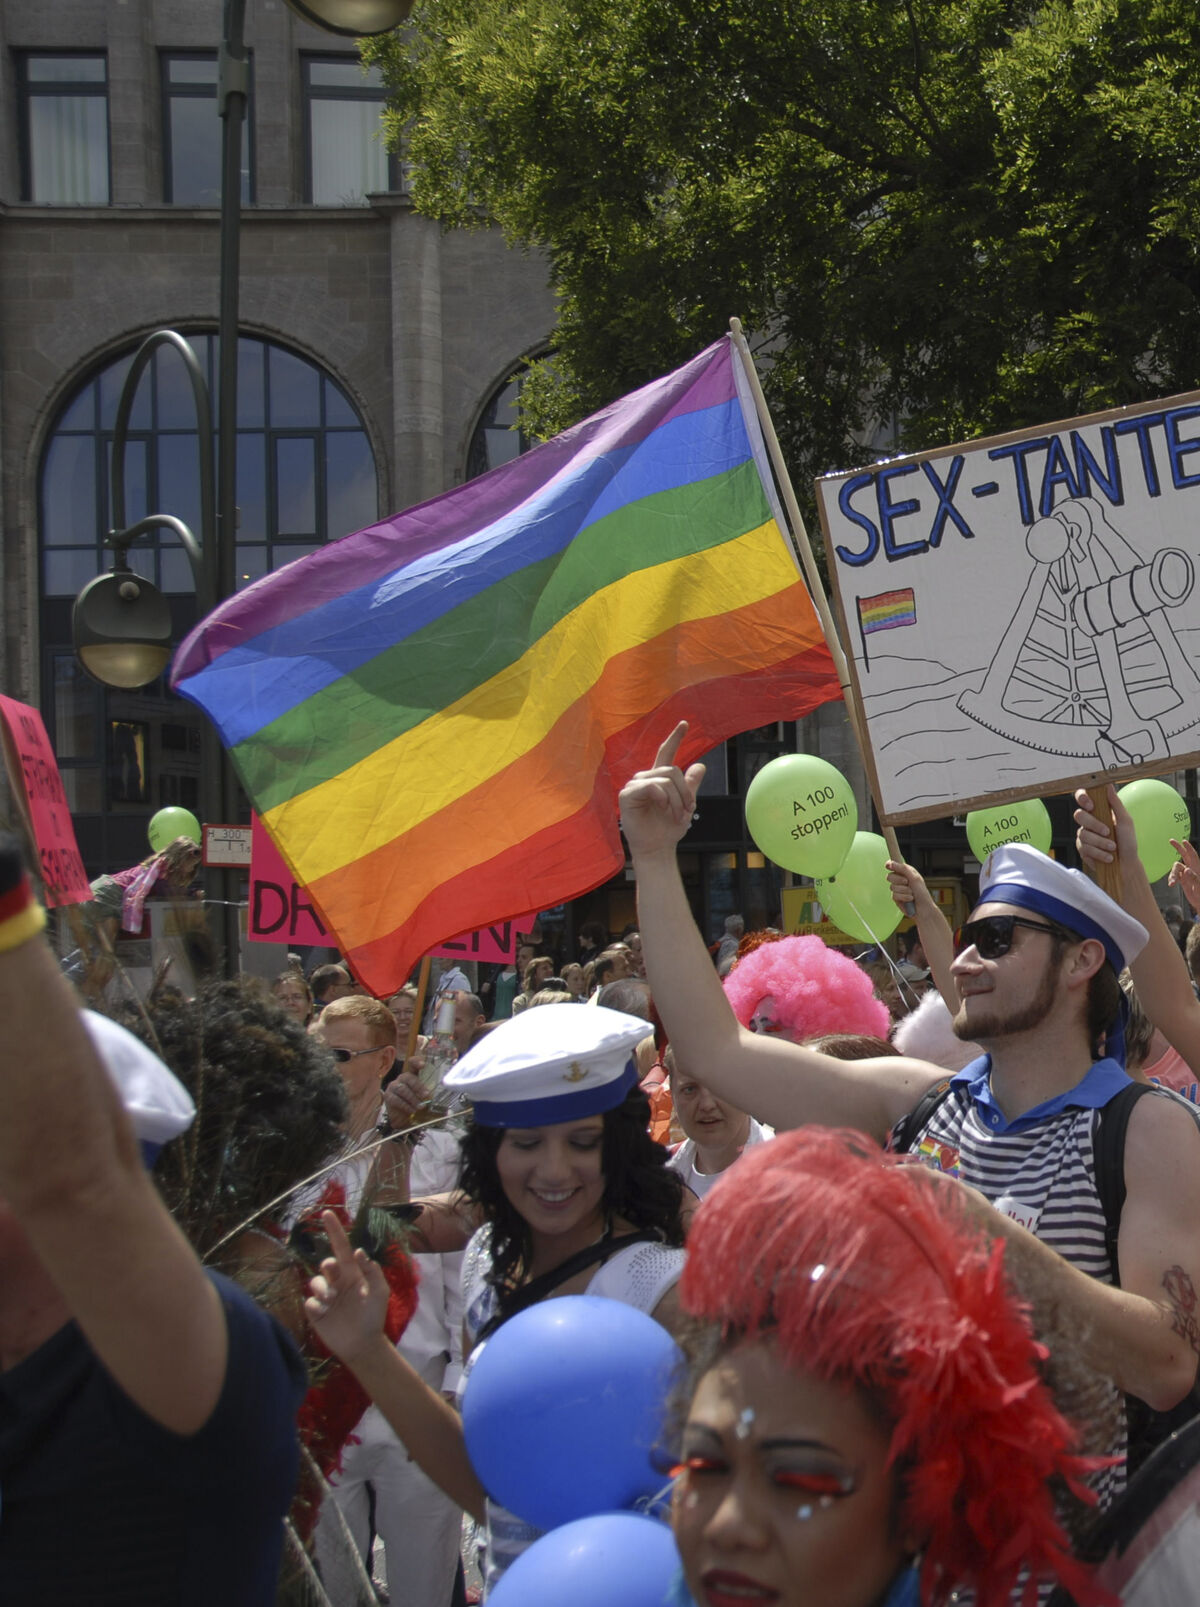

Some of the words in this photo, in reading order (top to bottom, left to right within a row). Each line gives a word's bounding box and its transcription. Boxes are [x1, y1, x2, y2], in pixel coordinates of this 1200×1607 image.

[793, 801, 806, 816] A
[807, 786, 835, 807] 100
[223, 829, 242, 839] 300
[791, 803, 849, 840] stoppen!
[983, 825, 993, 837] A
[994, 815, 1019, 832] 100
